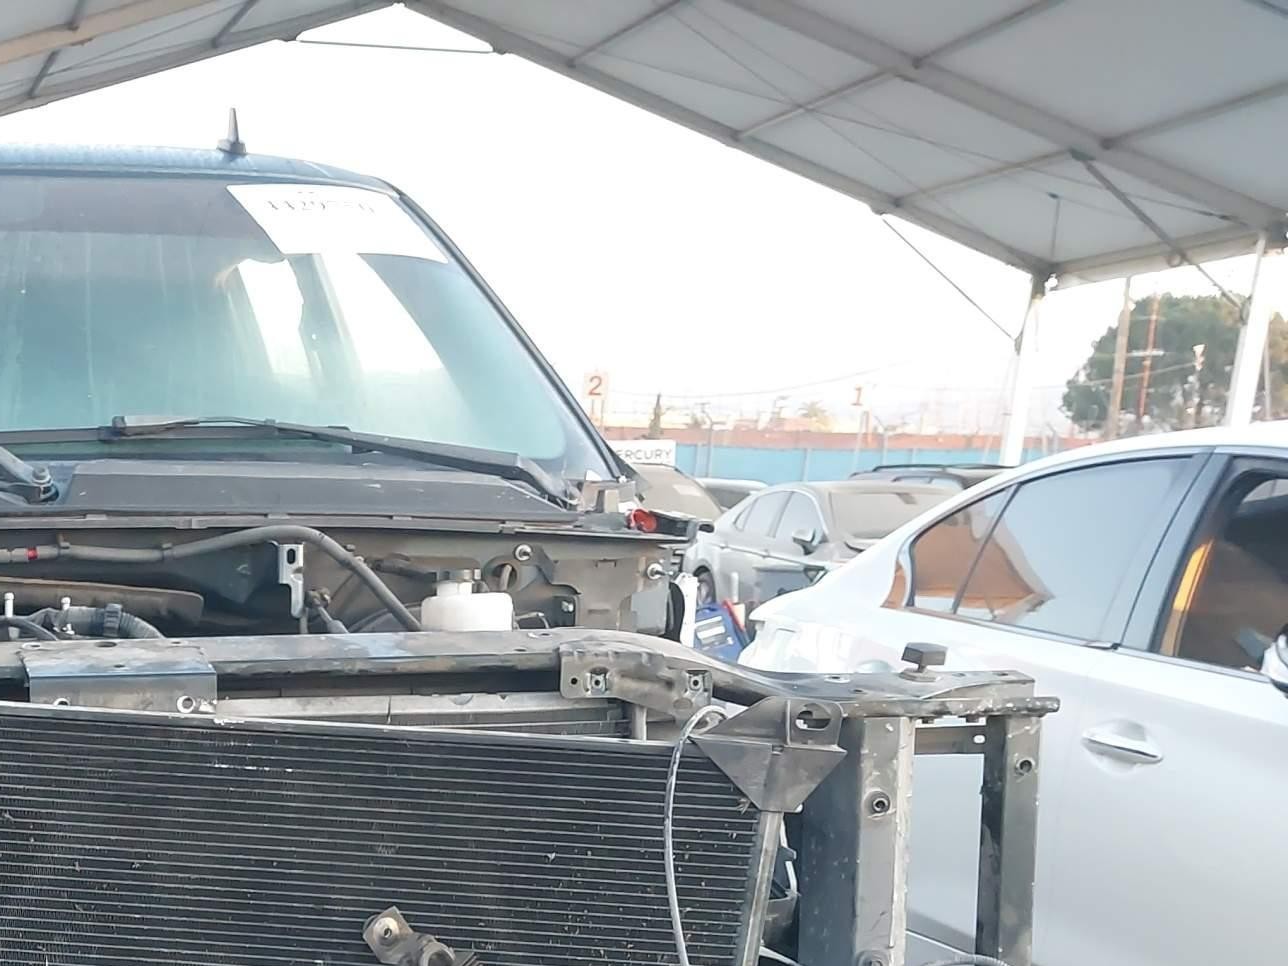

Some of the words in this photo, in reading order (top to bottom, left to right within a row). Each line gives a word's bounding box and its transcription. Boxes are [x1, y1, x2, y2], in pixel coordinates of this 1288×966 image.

[588, 375, 602, 396] 2
[851, 385, 864, 406] 1
[615, 449, 672, 460] ERCURY
